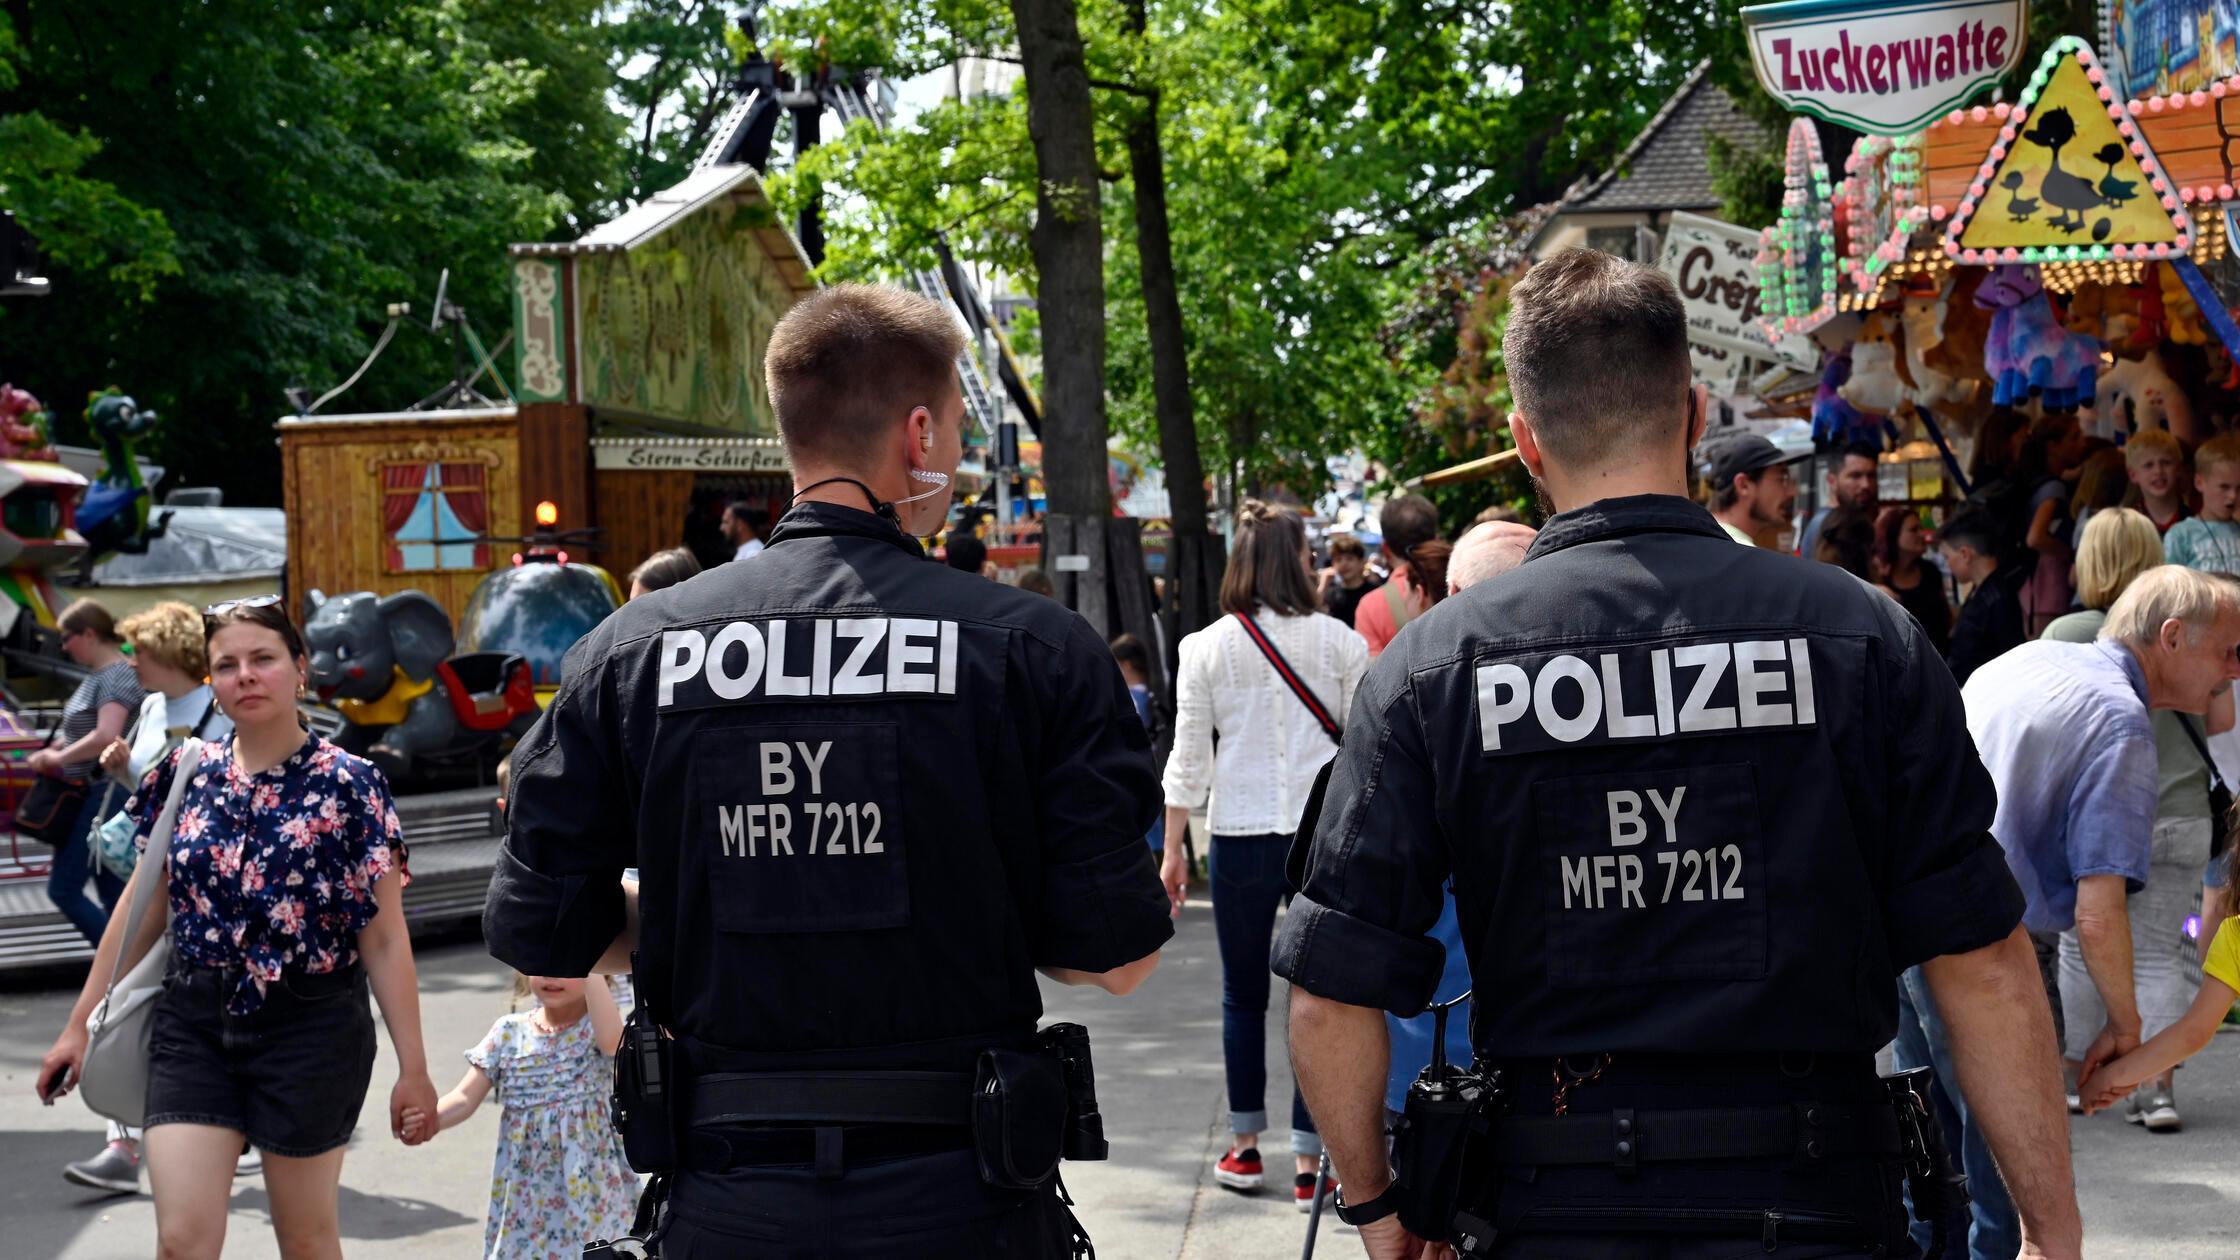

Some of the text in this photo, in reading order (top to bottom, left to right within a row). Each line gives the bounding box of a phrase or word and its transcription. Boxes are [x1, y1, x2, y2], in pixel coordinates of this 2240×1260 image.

[1772, 19, 2008, 95] Zuckerwatte
[1679, 246, 1763, 324] Crêp
[627, 448, 783, 471] Stern-Schießen
[658, 618, 958, 707] POLIZEI
[1476, 638, 1816, 751] POLIZEI
[760, 741, 833, 796] BY
[718, 801, 884, 857] MFR 7212
[1607, 786, 1687, 847] BY
[1561, 844, 1745, 909] MFR 7212
